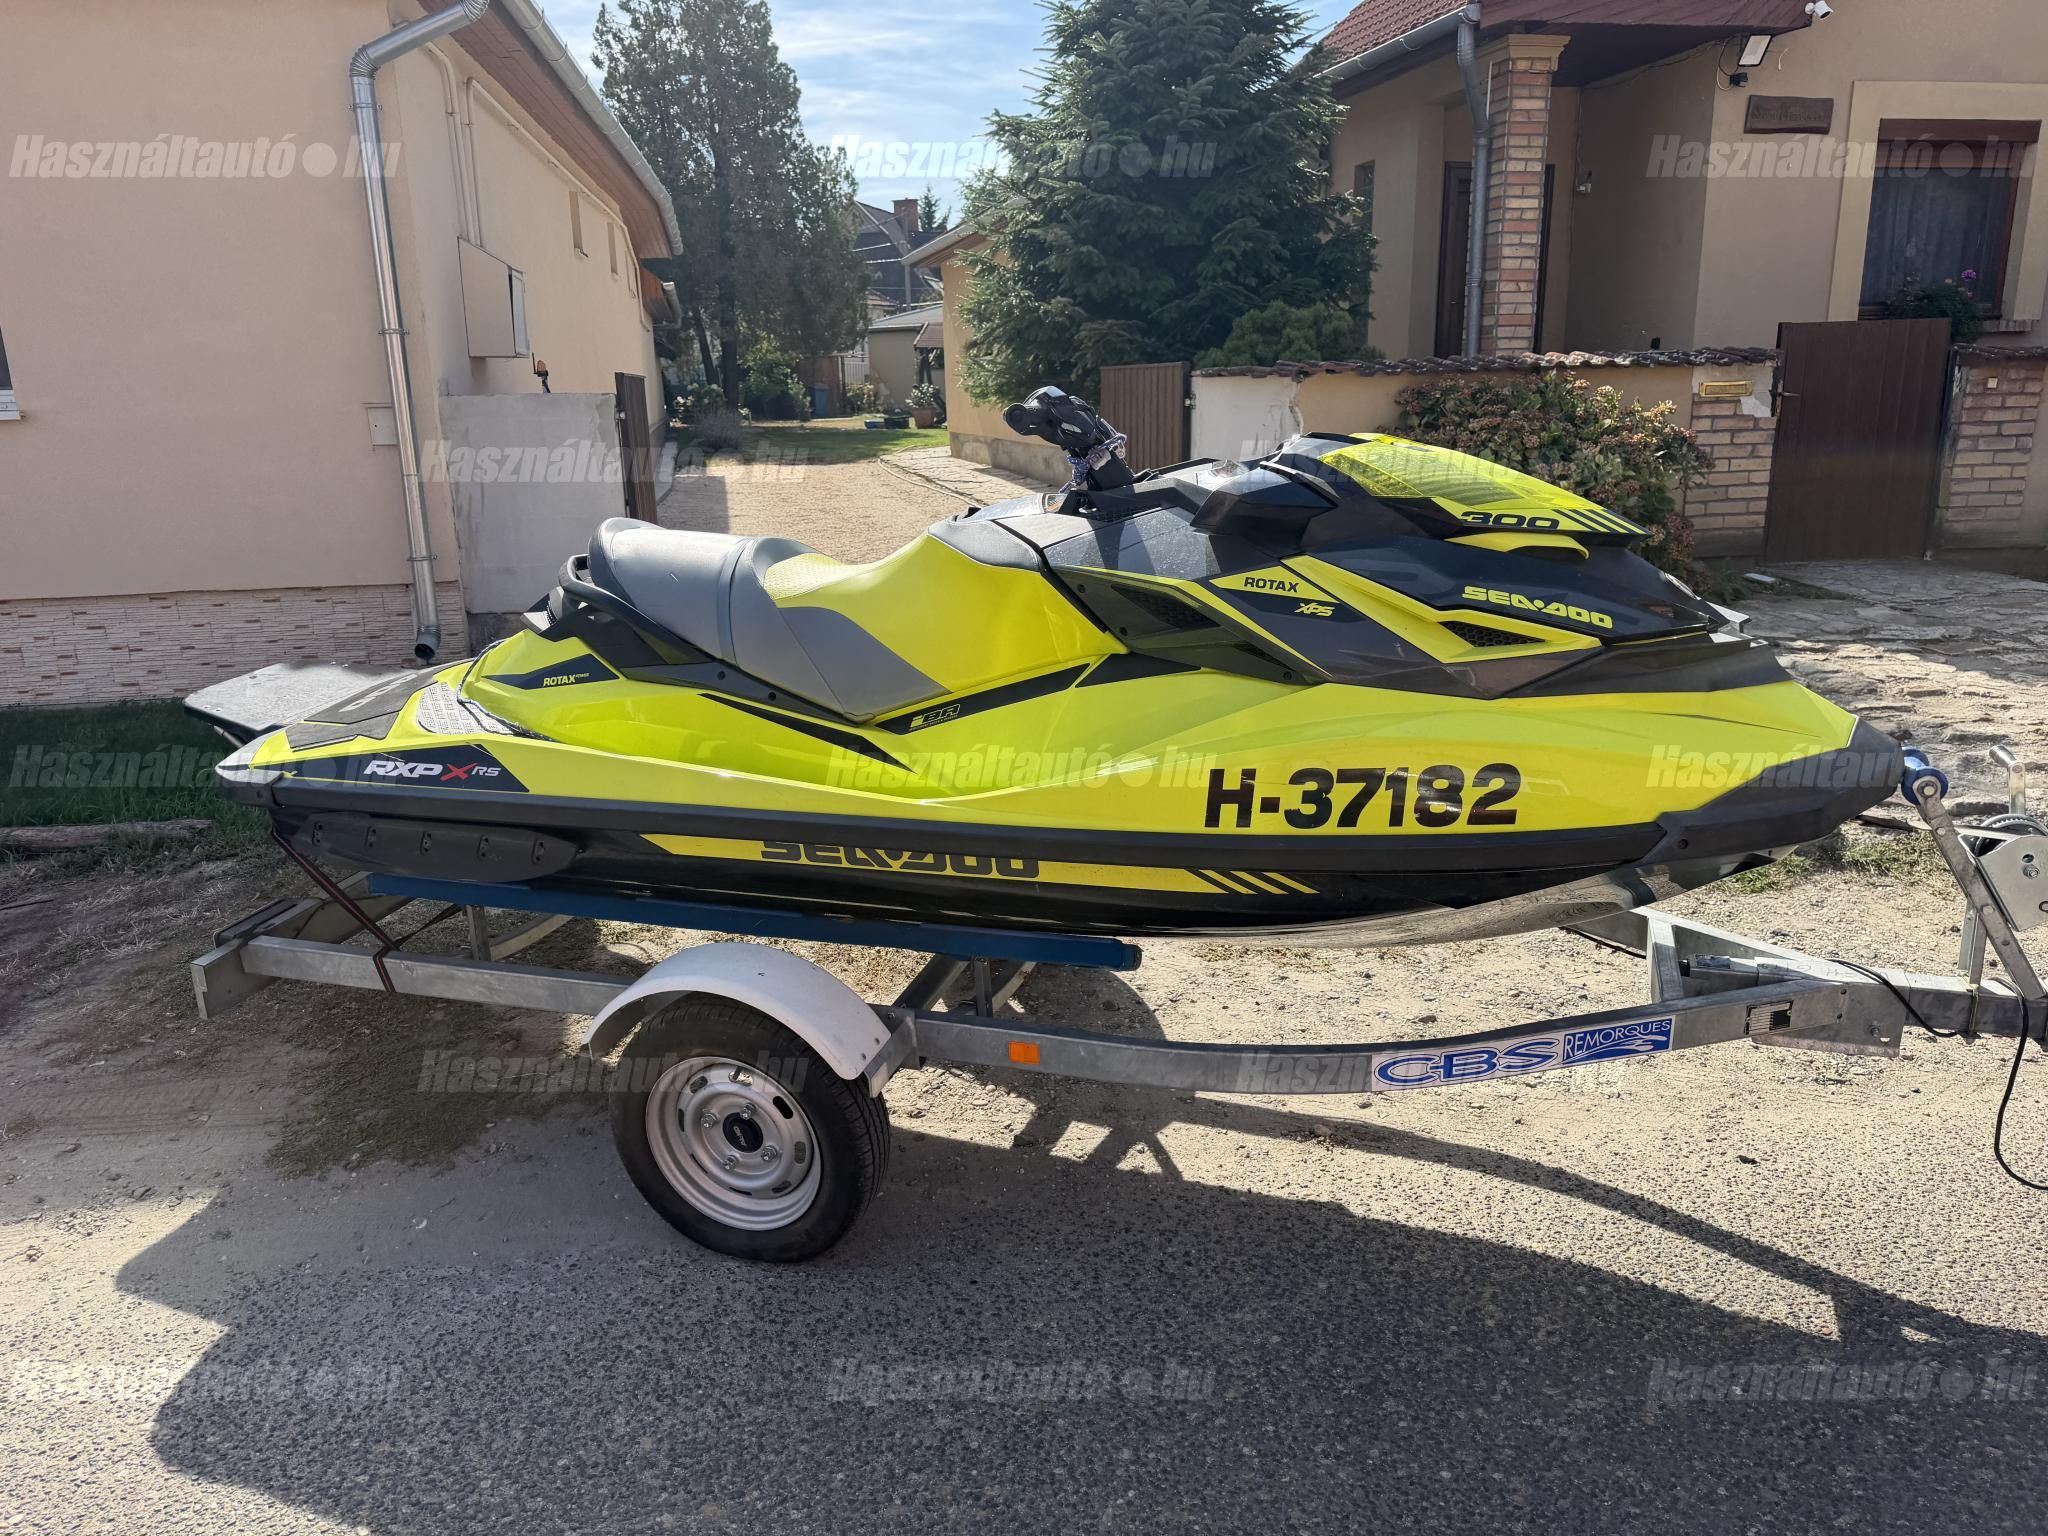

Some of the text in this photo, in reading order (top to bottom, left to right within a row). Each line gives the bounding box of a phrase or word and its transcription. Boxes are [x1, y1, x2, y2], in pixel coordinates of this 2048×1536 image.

[1461, 511, 1560, 529] 300
[1244, 577, 1299, 592] ROTAX
[1294, 602, 1335, 617] XPS
[543, 674, 576, 687] ROTAX
[1205, 763, 1521, 829] H-37182
[1373, 1037, 1560, 1087] CBS
[1564, 1019, 1671, 1061] REMORQUES
